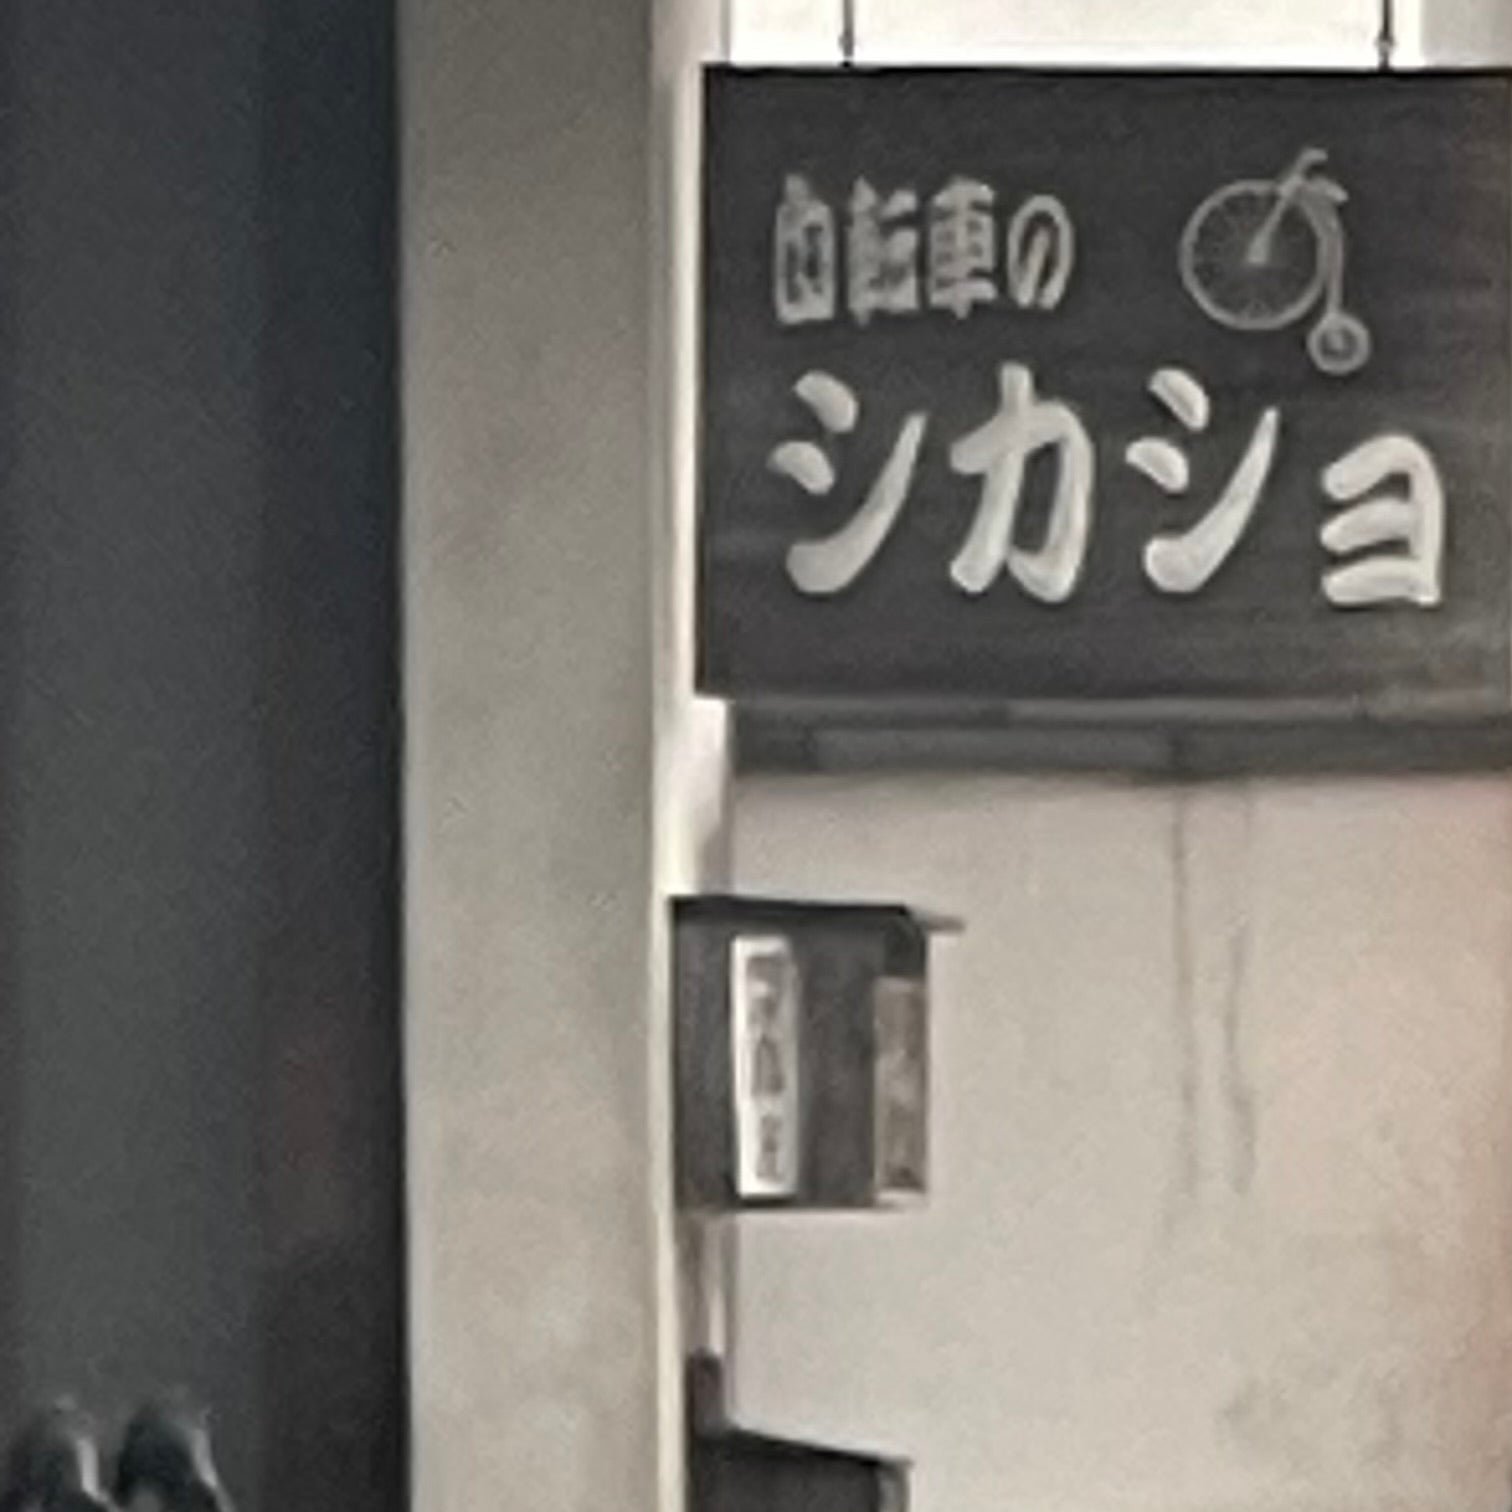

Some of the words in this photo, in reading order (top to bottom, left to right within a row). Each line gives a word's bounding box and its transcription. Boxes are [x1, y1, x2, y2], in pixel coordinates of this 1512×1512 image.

[775, 175, 1073, 325] 自転車の
[768, 362, 1444, 606] シカショ
